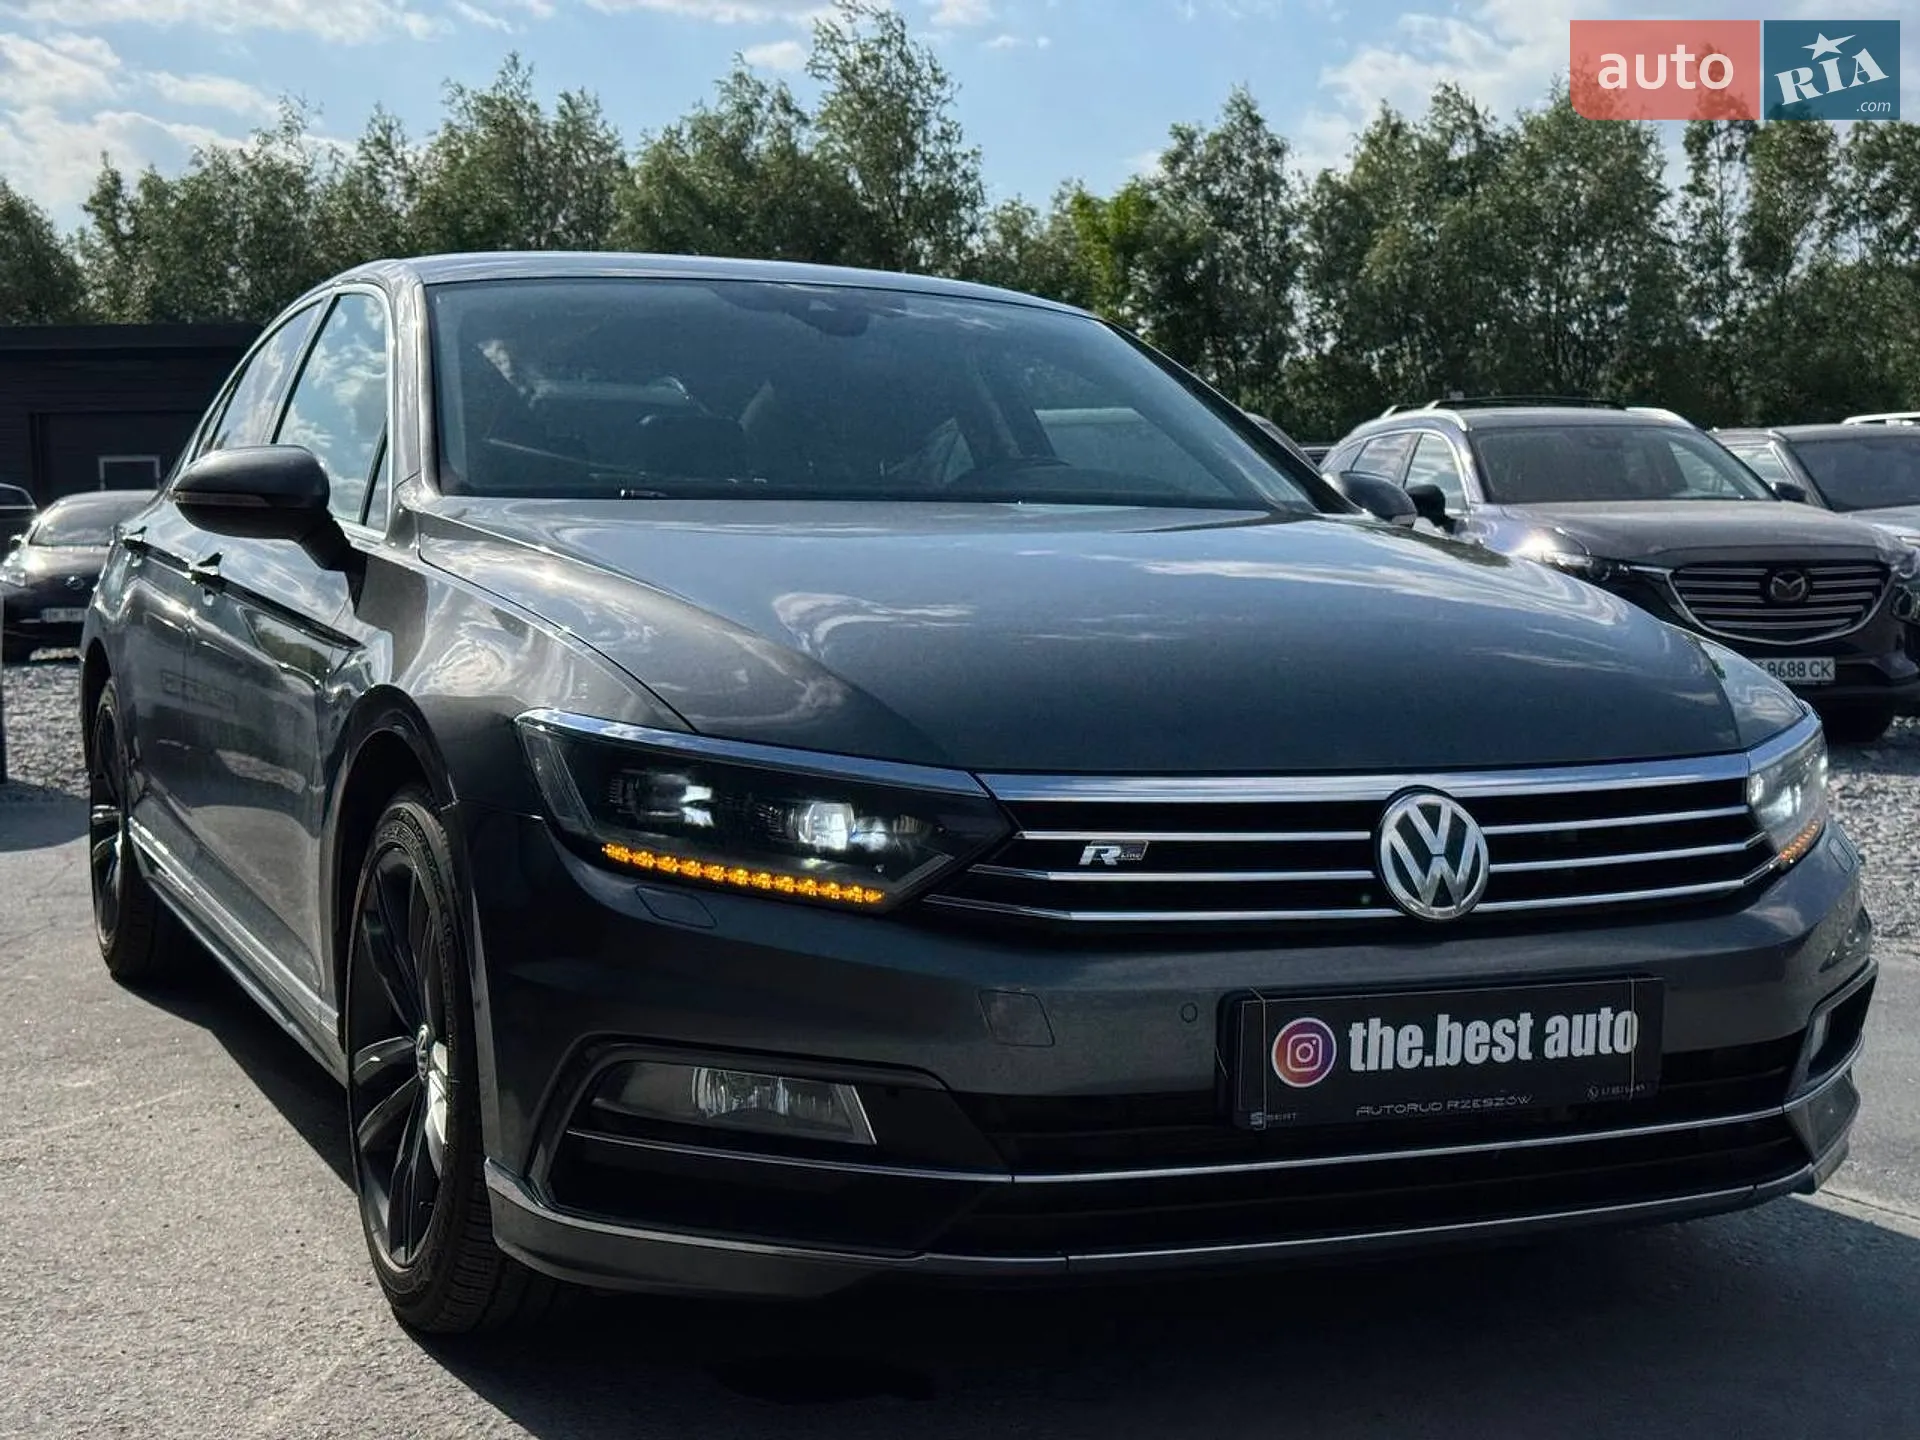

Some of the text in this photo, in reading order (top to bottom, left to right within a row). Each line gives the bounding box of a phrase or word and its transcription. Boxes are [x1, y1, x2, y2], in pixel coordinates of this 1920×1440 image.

[1809, 659, 1833, 678] CK
[1078, 845, 1121, 866] R
[1348, 1006, 1639, 1073] the.best auto
